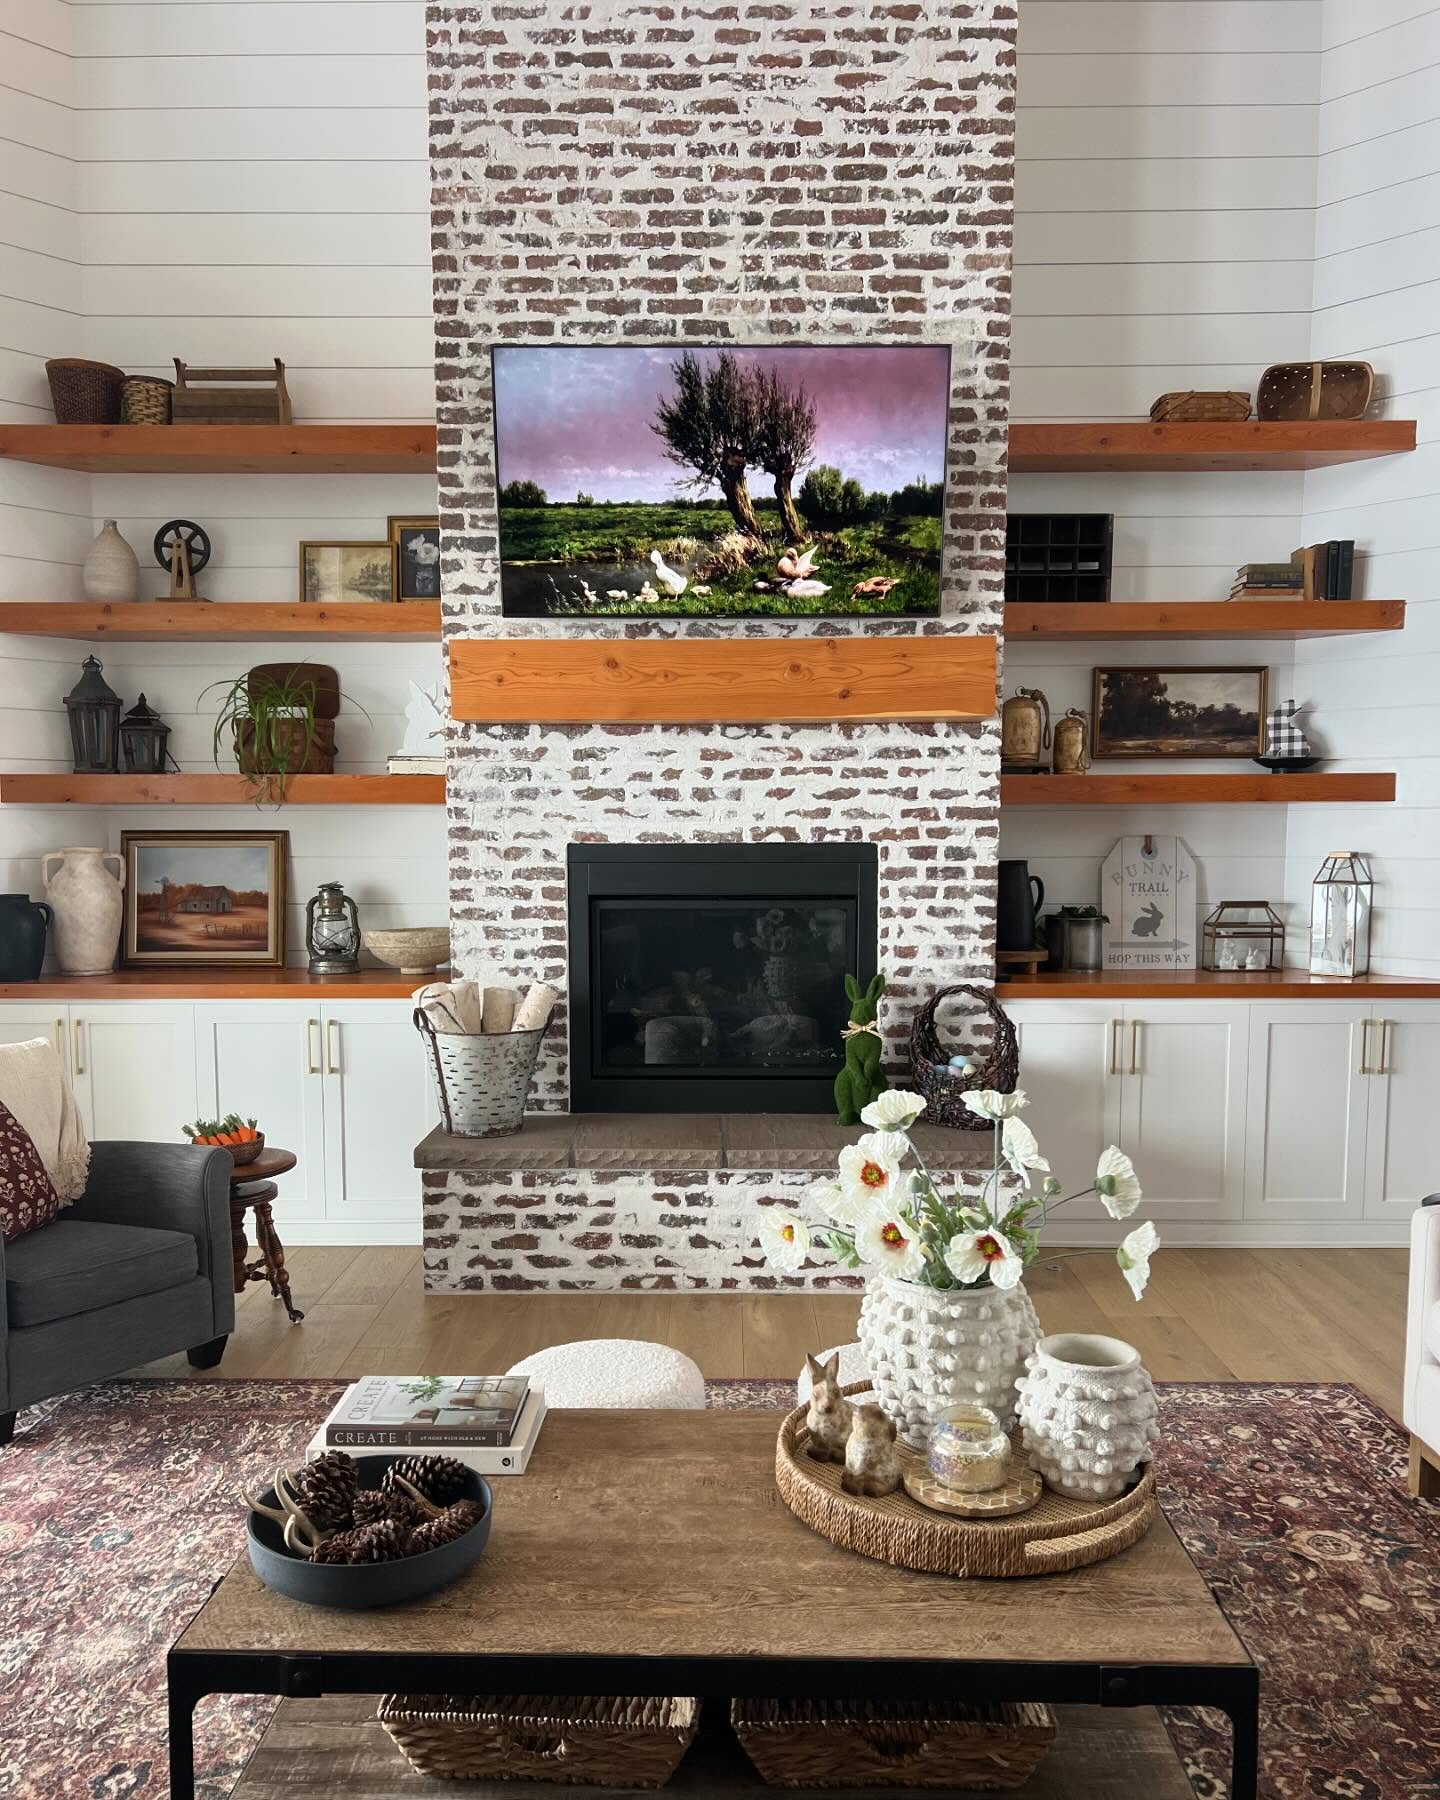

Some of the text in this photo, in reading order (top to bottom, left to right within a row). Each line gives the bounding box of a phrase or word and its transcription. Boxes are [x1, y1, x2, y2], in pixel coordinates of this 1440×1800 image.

[1112, 862, 1190, 886] BUNNY
[1128, 882, 1169, 893] TRAIL
[1108, 953, 1190, 964] HOP THIS WAY
[348, 1378, 387, 1420] CREATE
[334, 1432, 397, 1443] CREATE
